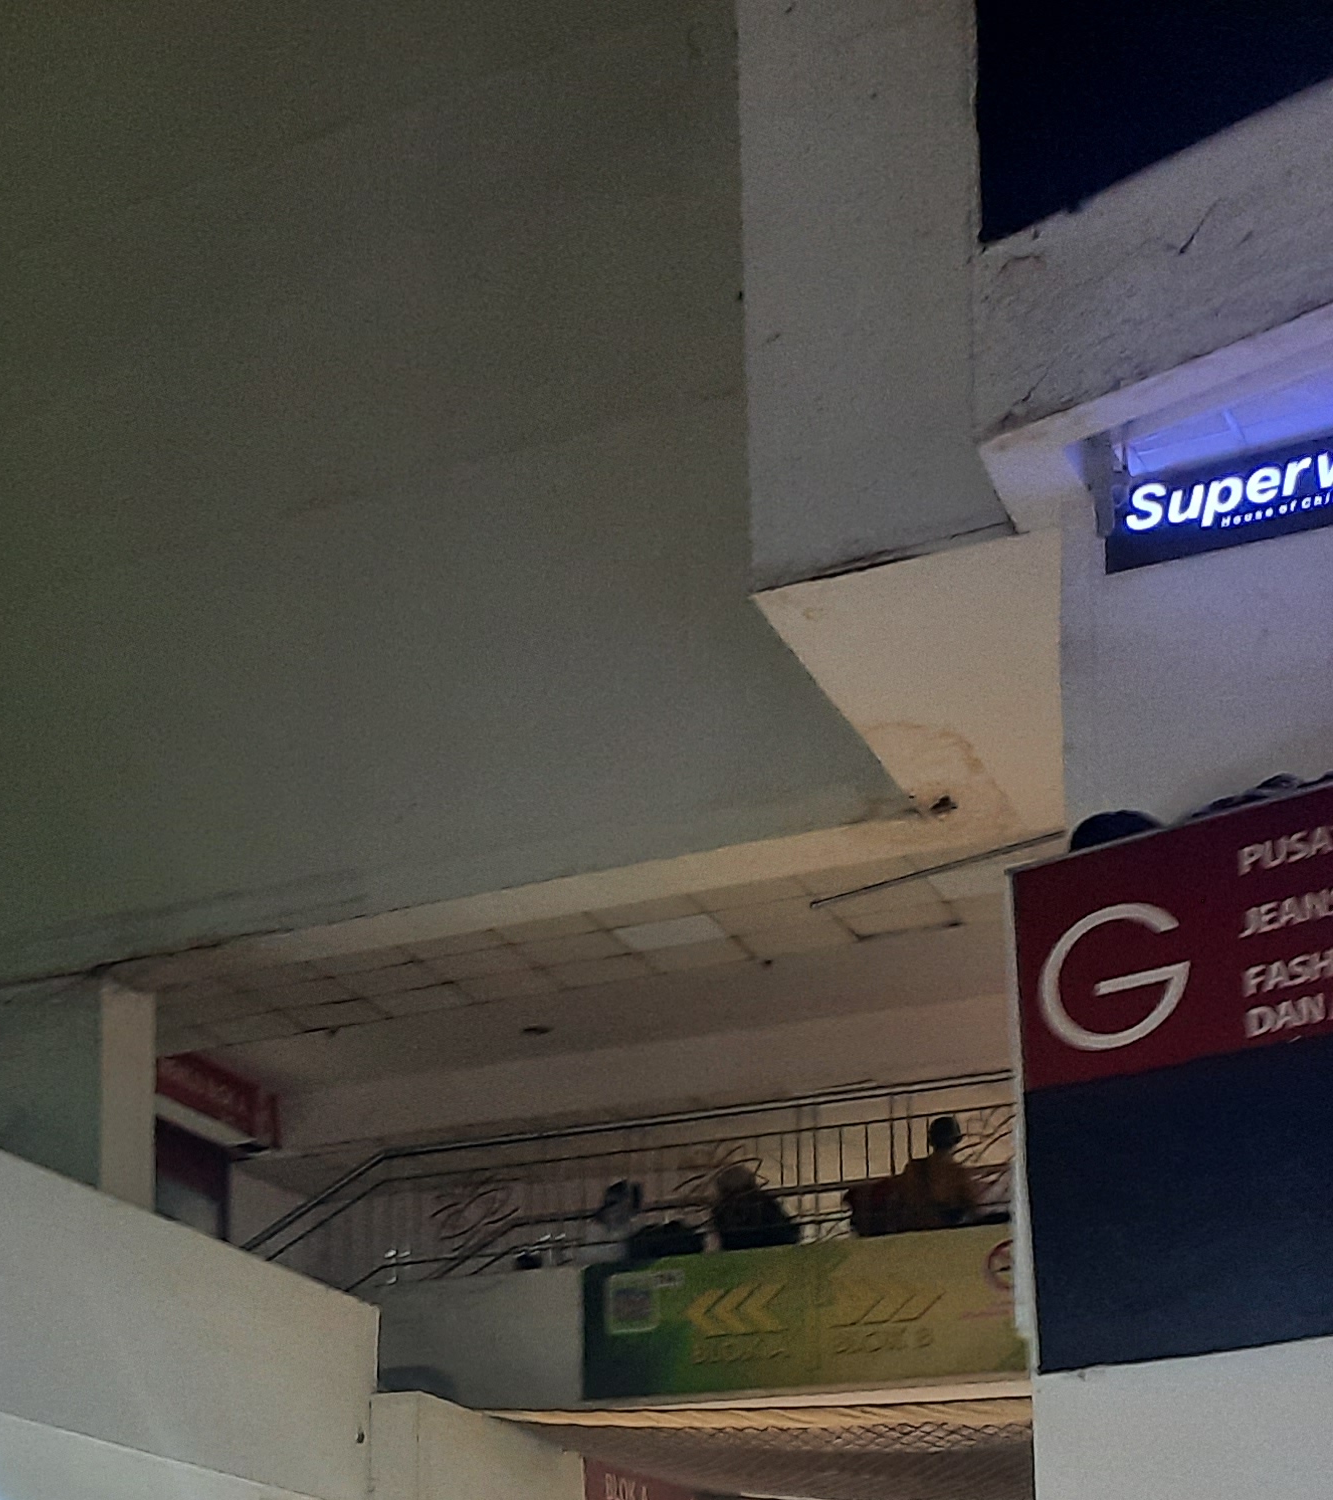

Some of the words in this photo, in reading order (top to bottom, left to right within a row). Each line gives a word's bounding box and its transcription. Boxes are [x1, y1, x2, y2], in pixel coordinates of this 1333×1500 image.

[1237, 825, 1333, 877] PUSA
[1238, 887, 1333, 939] JEAN
[1038, 902, 1192, 1051] G
[1244, 992, 1326, 1039] DAN
